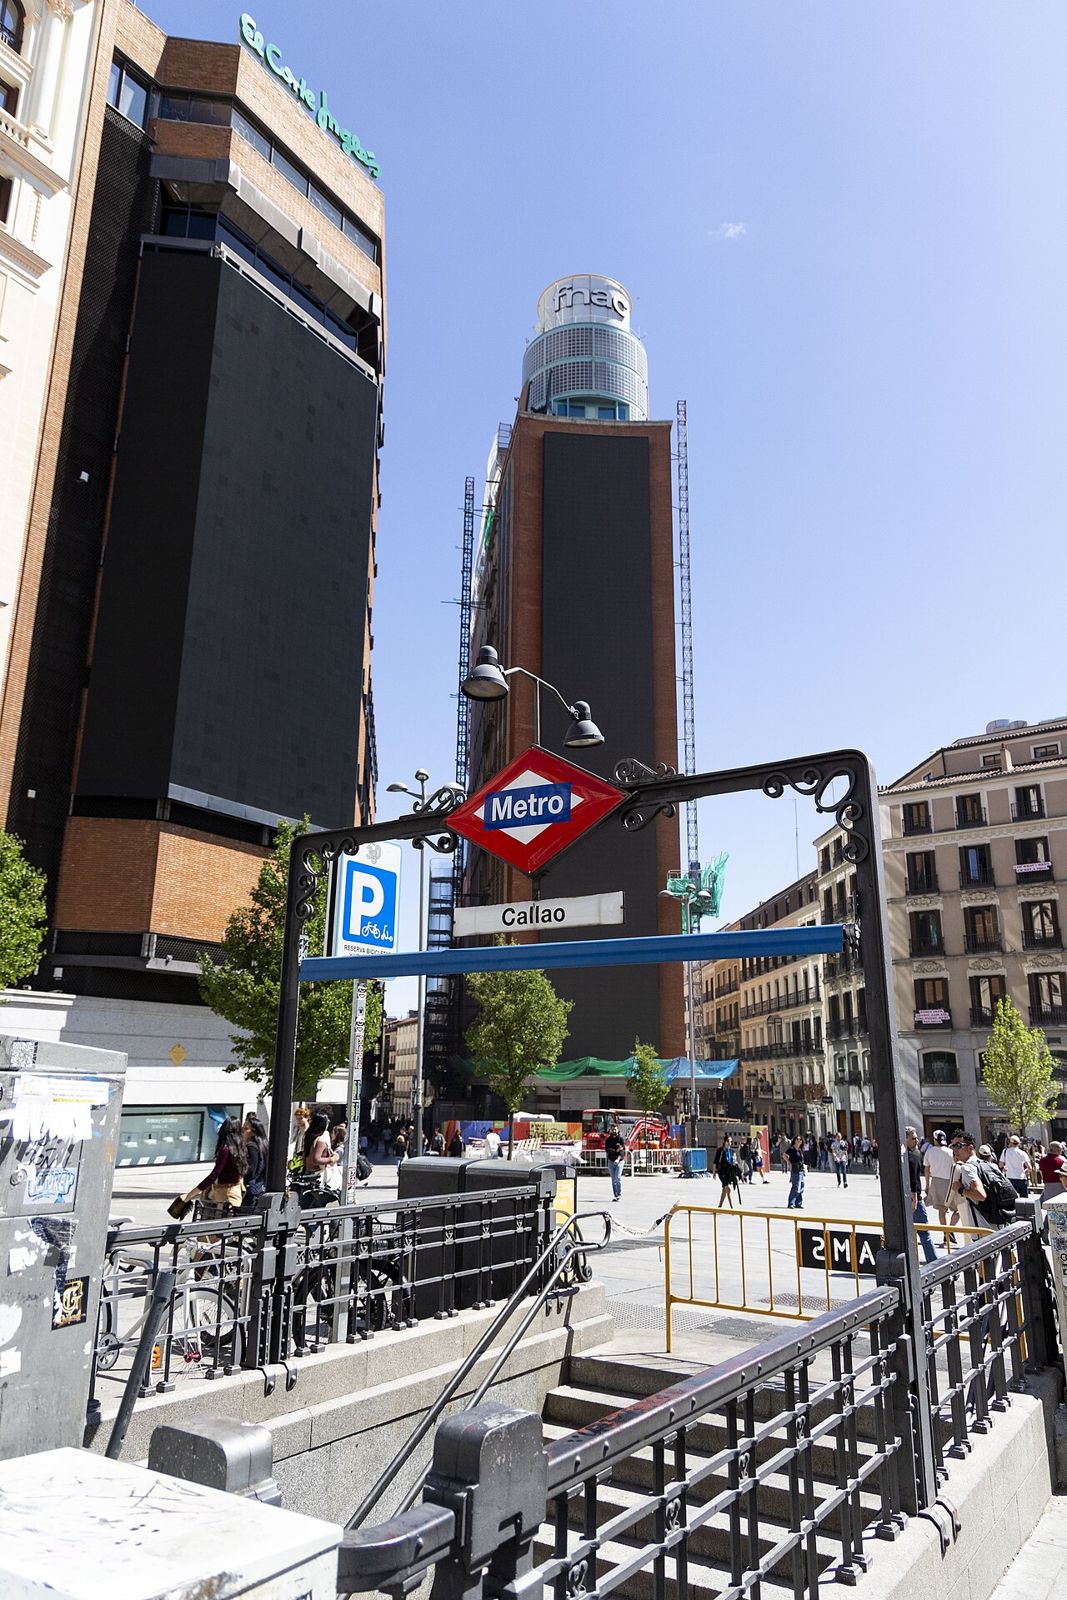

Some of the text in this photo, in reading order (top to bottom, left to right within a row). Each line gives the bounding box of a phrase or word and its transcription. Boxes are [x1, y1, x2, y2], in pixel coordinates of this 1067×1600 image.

[239, 13, 382, 179] El Corte Inglés
[553, 284, 630, 322] fnac
[491, 794, 564, 822] Metro
[348, 870, 385, 936] P
[502, 904, 566, 927] Callao
[344, 944, 365, 953] RESERVA
